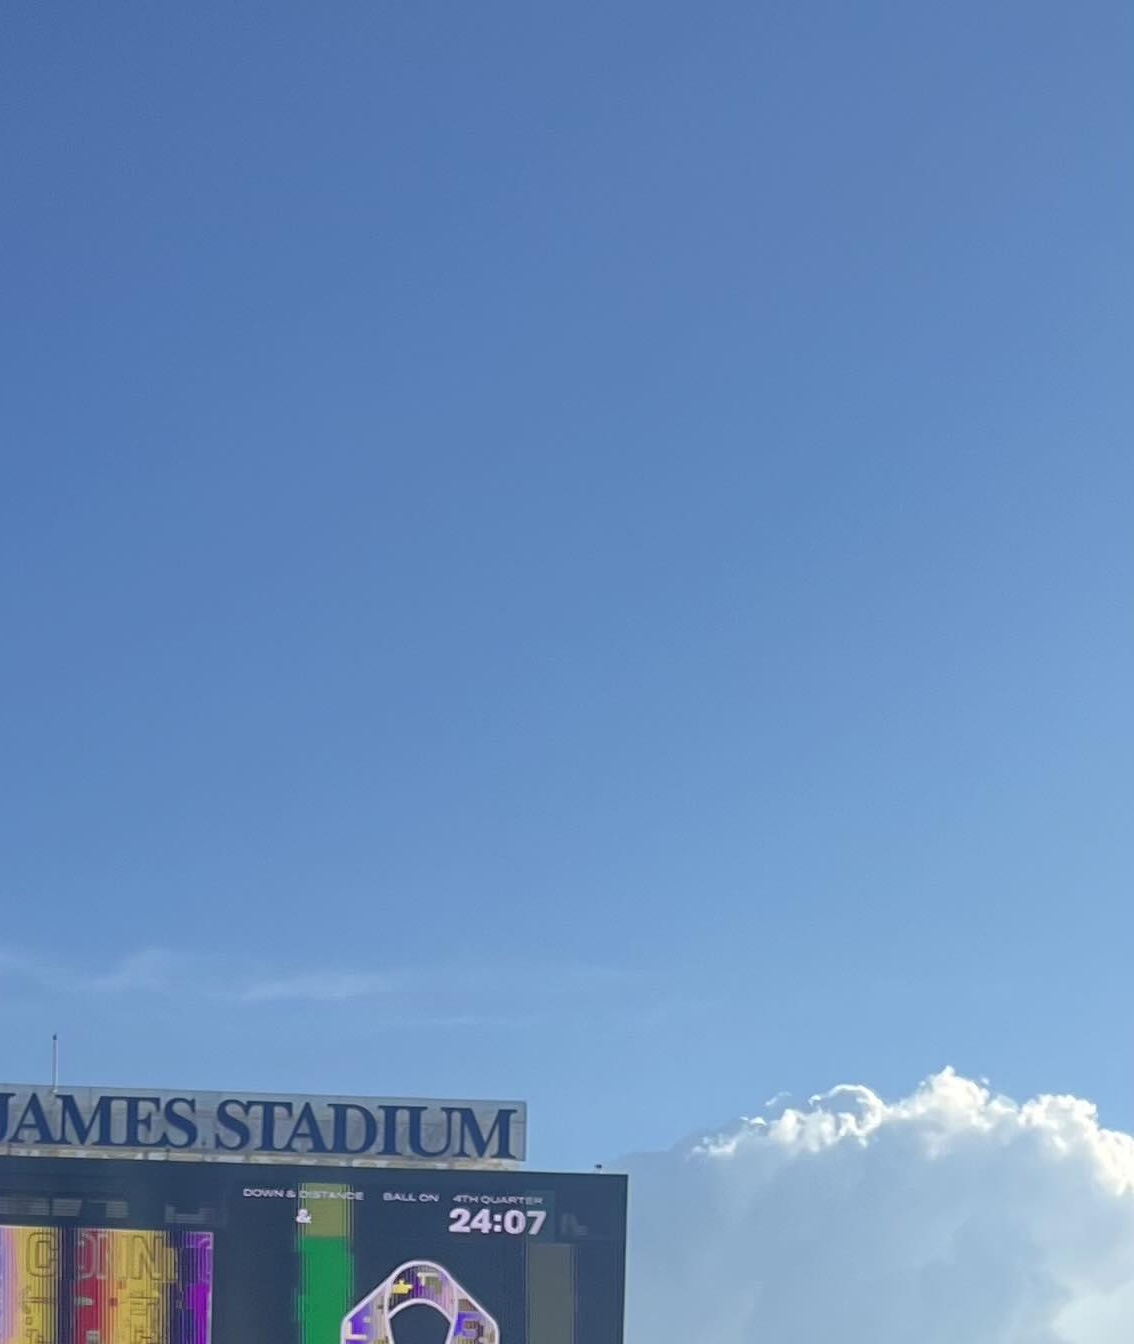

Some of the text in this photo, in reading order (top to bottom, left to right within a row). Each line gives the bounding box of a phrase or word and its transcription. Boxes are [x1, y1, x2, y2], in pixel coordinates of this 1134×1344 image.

[215, 1099, 518, 1159] STADIUM
[243, 1188, 365, 1200] DOWN & DISTANCE
[383, 1192, 439, 1202] BALL ON
[453, 1194, 544, 1205] 4TH QUARTER
[296, 1208, 312, 1223] &
[449, 1207, 547, 1236] 24:07
